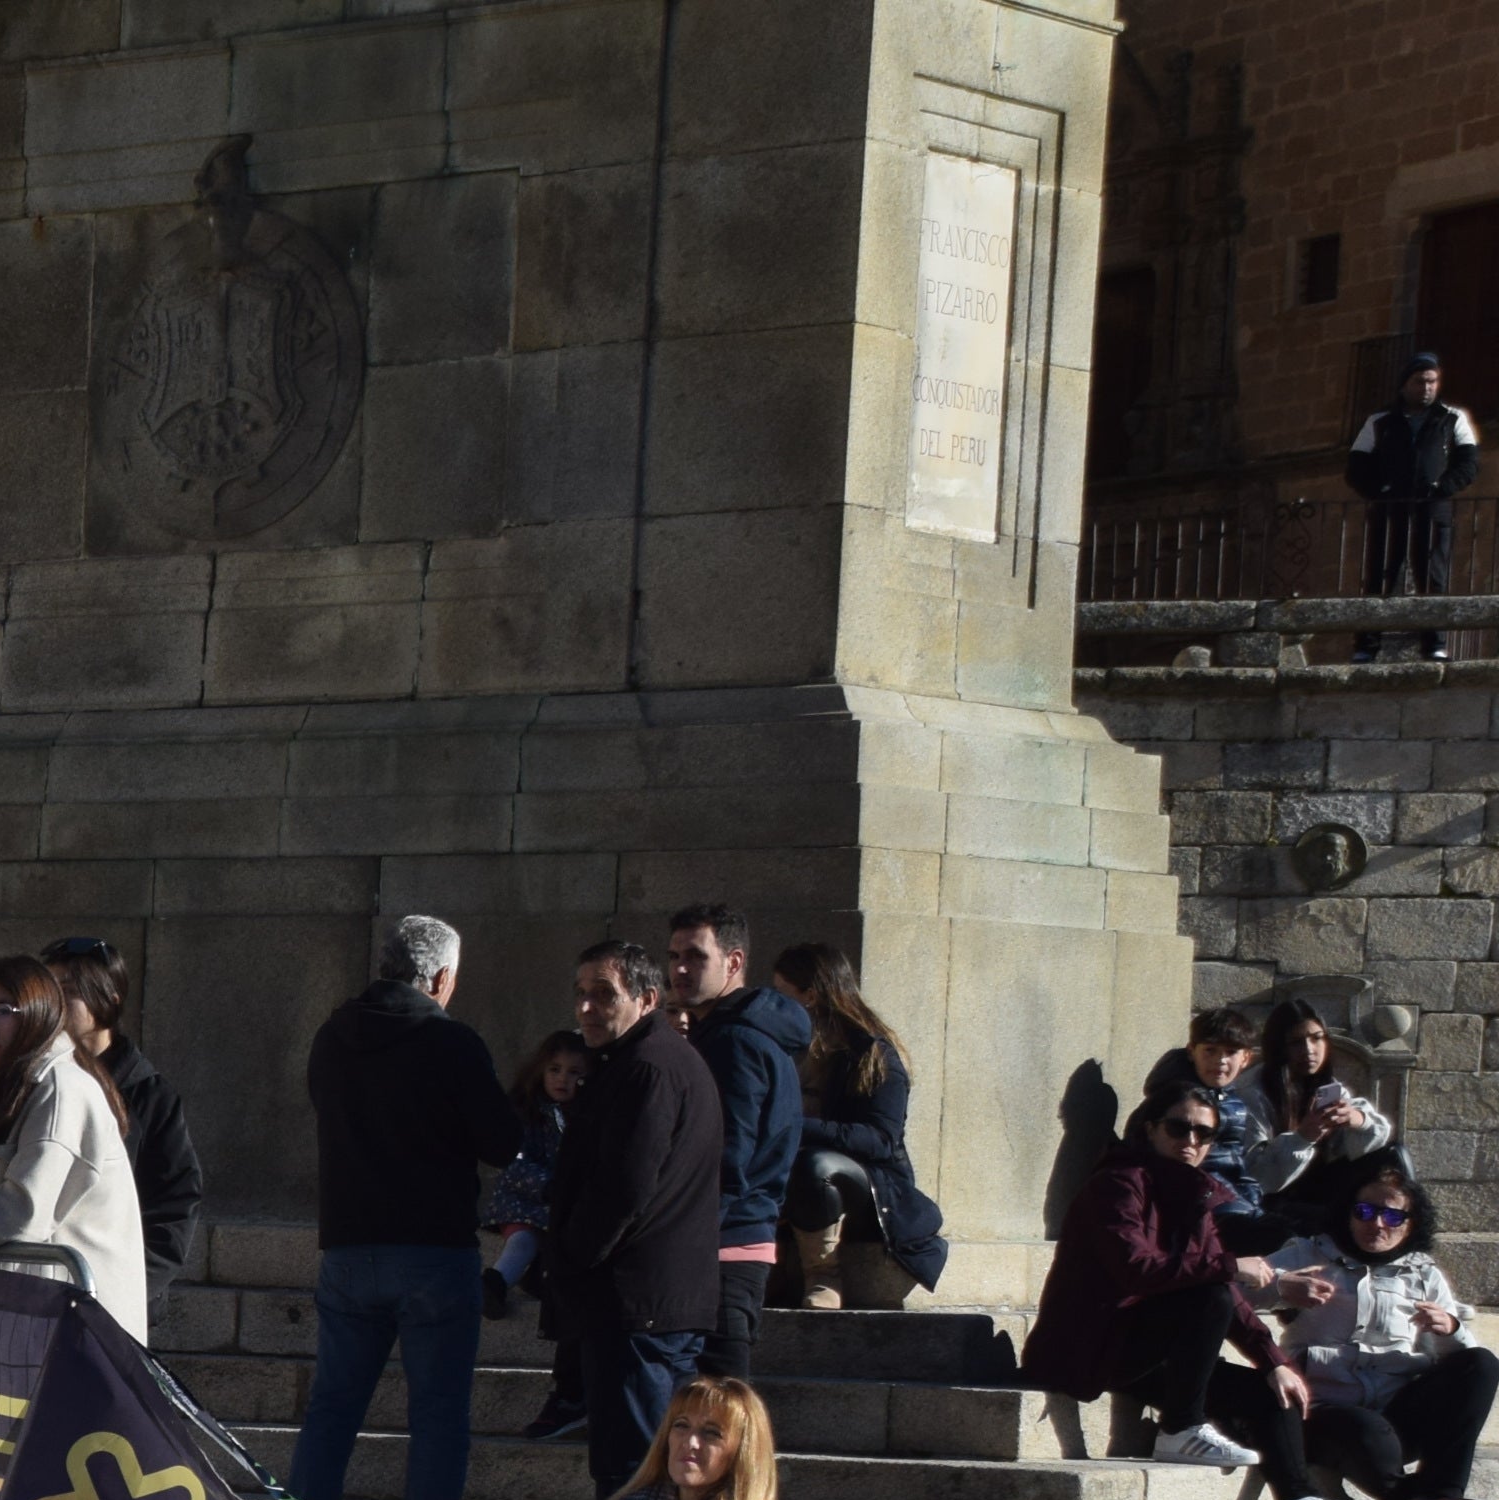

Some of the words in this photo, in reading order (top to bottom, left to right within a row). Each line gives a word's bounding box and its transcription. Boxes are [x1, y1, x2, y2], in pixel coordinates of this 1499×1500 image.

[919, 217, 1010, 268] FRANCISCO
[923, 278, 998, 324] PIZARRO
[913, 374, 1000, 417] CONQUISTADOR
[920, 427, 945, 459] DEL
[950, 433, 987, 466] PERU
